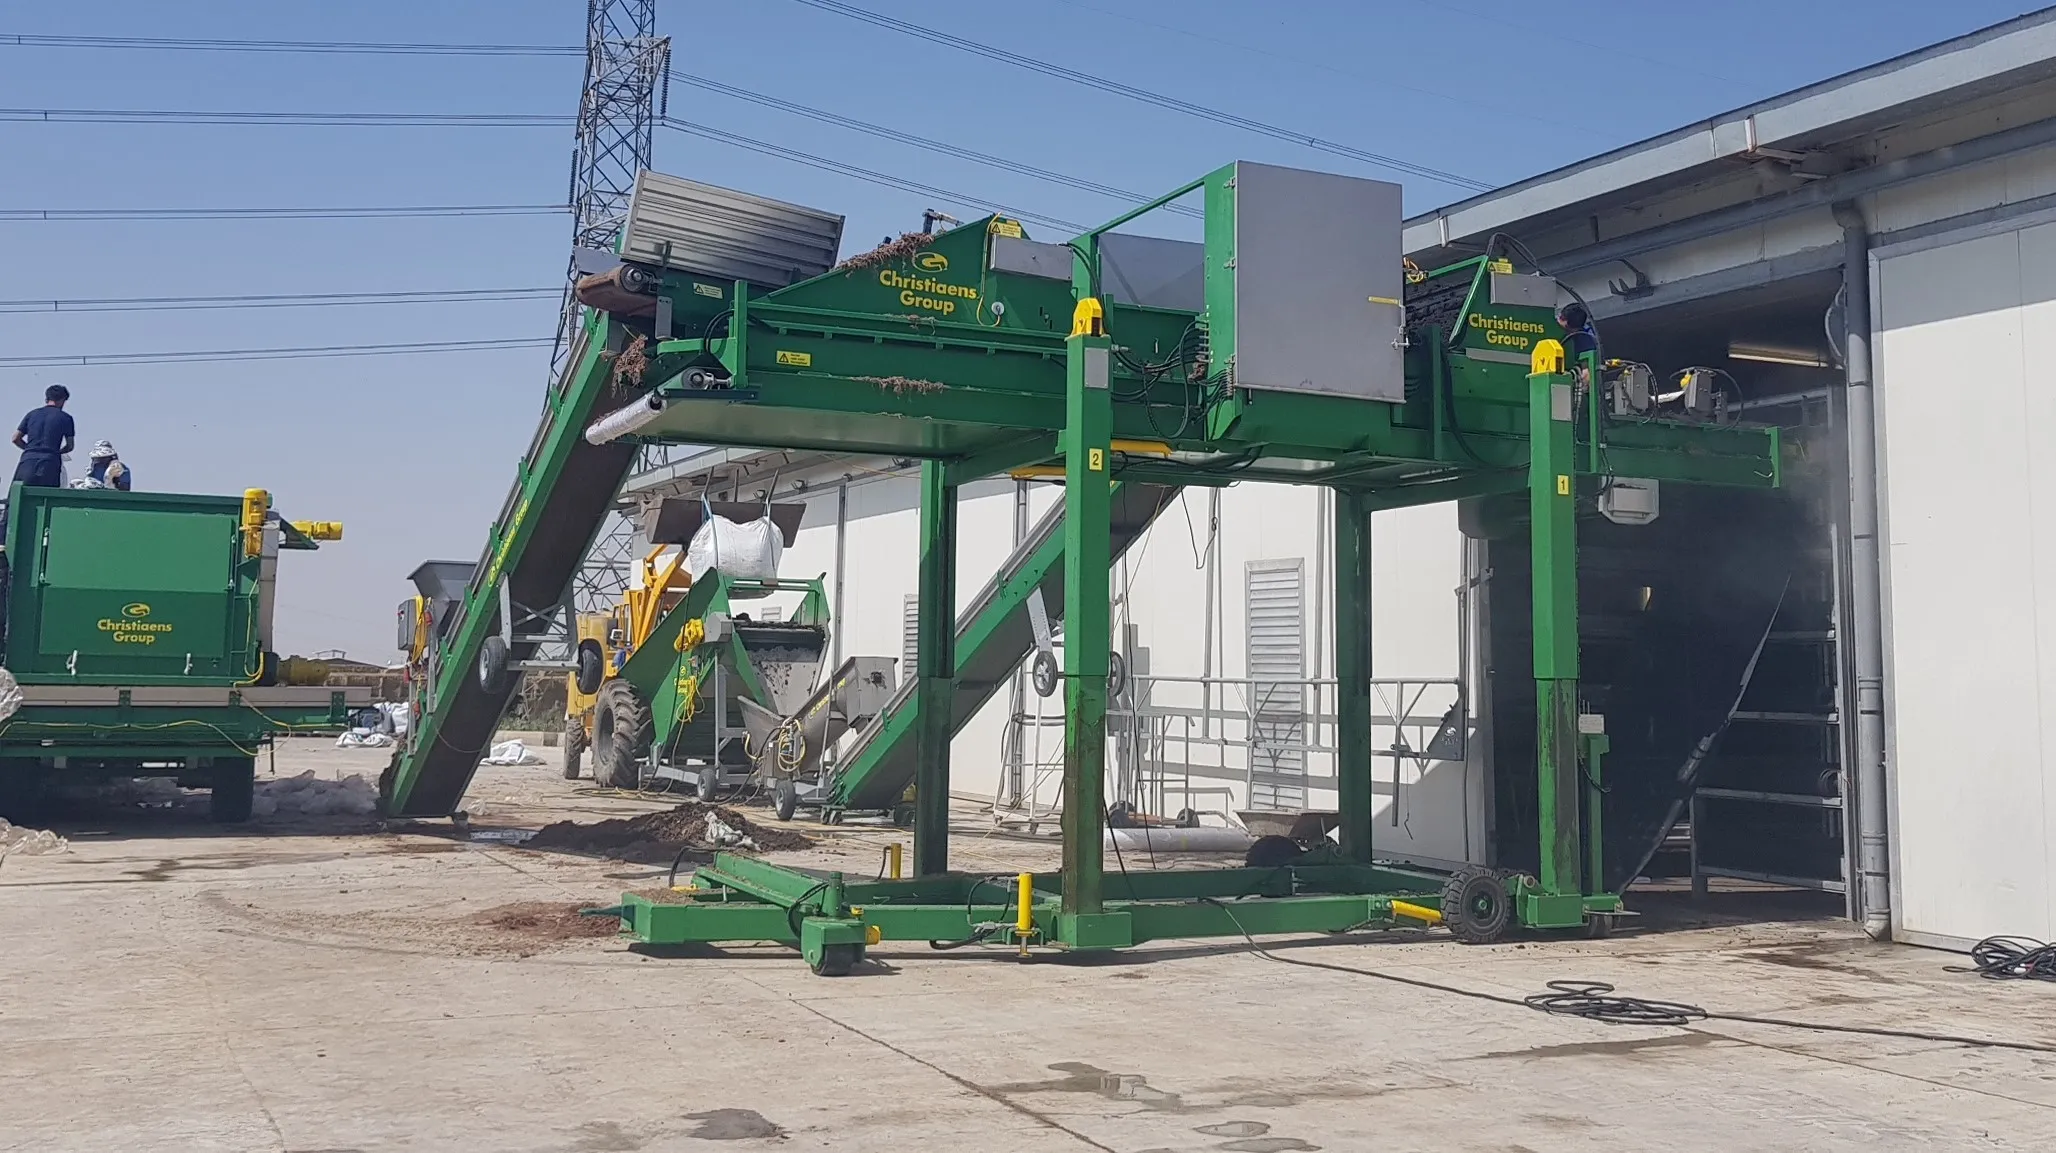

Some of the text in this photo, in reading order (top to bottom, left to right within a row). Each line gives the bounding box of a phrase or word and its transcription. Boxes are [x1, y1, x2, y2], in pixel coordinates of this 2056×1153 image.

[880, 269, 977, 299] Christiaens
[900, 290, 955, 315] Group
[1468, 313, 1544, 333] Christiaens
[1486, 329, 1529, 350] Group
[1092, 453, 1100, 466] 2
[97, 618, 172, 632] Christiaens
[113, 631, 155, 645] Group
